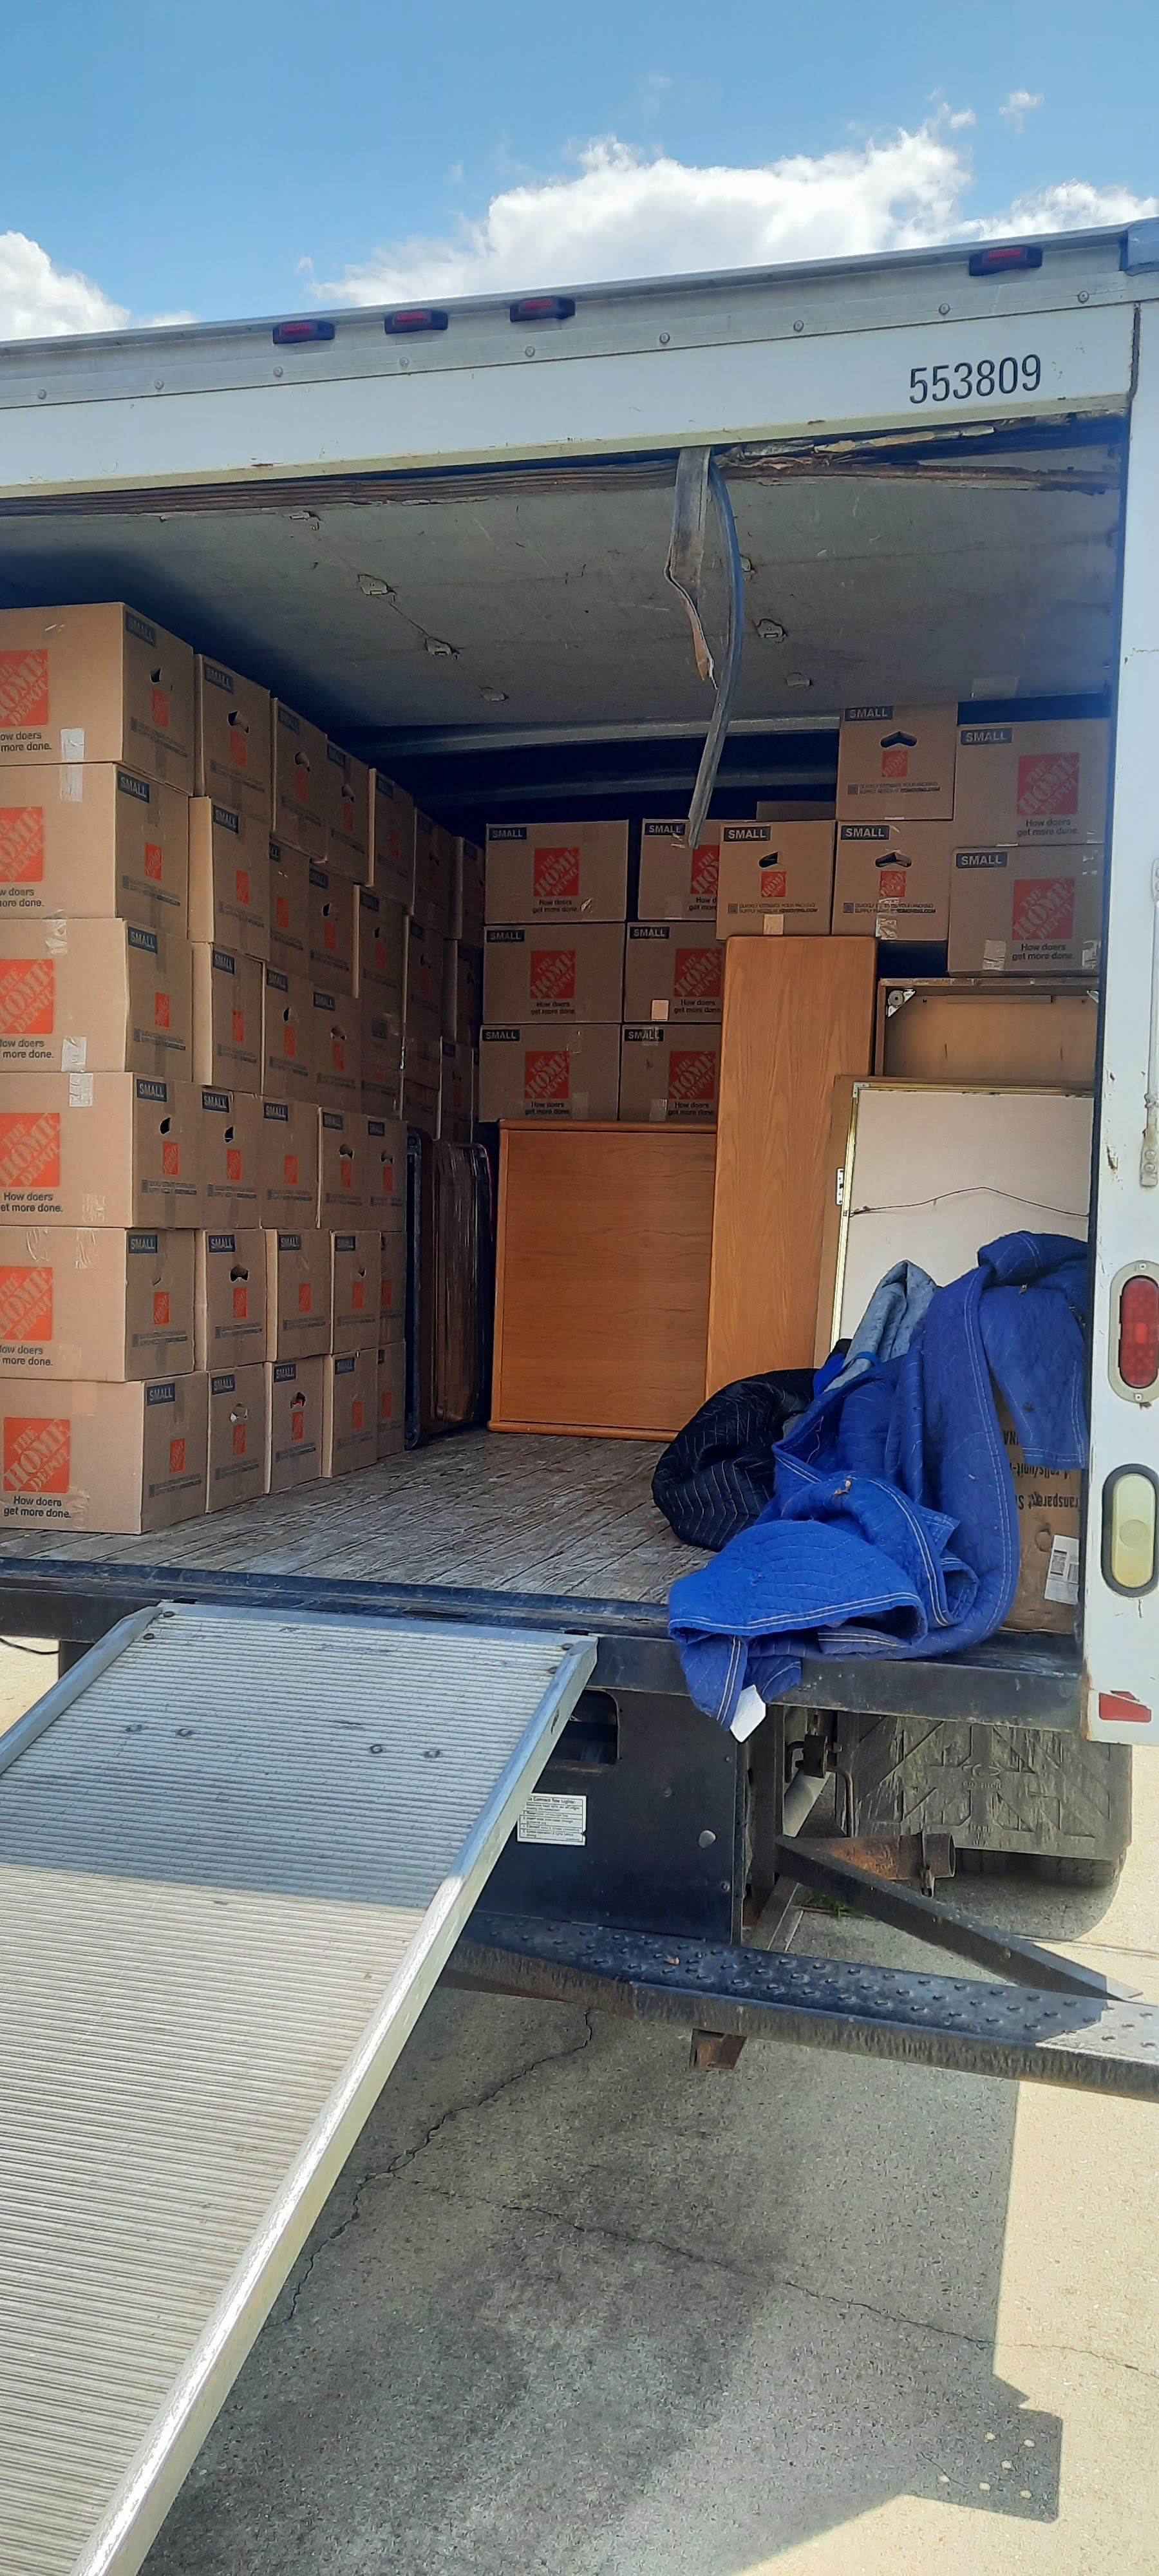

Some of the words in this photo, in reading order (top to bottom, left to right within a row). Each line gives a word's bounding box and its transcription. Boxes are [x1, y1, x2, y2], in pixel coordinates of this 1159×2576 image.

[909, 354, 1041, 404] 553809
[128, 617, 154, 643] SMALL
[849, 707, 887, 718] SMALL
[15, 732, 42, 741] doers
[966, 731, 1007, 742] SMALL
[120, 777, 147, 798] SMALL
[1018, 752, 1079, 815] HOME
[493, 829, 523, 838] SMALL
[649, 825, 681, 833] SMALL
[728, 829, 766, 839] SMALL
[846, 828, 885, 837] SMALL
[1017, 828, 1030, 837] get
[961, 855, 1002, 866] SMALL
[534, 848, 579, 896] HOME
[692, 862, 719, 894] HO
[8, 888, 34, 896] doers
[19, 898, 44, 907] done.
[1013, 880, 1075, 940] HOME
[490, 932, 521, 940] SMALL
[634, 929, 665, 937] SMALL
[131, 931, 155, 949] SMALL
[1021, 943, 1041, 951] How
[1042, 943, 1066, 951] doers
[1012, 953, 1026, 961] get
[531, 951, 576, 998] HOME
[674, 949, 721, 997] HOME
[628, 1030, 660, 1039] SMALL
[18, 1039, 44, 1047] doers
[28, 1050, 54, 1058] done.
[525, 1052, 570, 1099] HOME
[669, 1052, 715, 1099] HOME
[139, 1083, 164, 1098] SMALL
[203, 1096, 227, 1109] SMALL
[265, 1104, 287, 1118] SMALL
[4, 1192, 24, 1201] How
[26, 1192, 53, 1201] doers
[12, 1204, 35, 1212] more
[37, 1204, 62, 1212] done.
[131, 1238, 155, 1250] SMALL
[211, 1237, 233, 1249] SMALL
[17, 1346, 43, 1354] doers
[28, 1357, 53, 1366] done.
[214, 1378, 234, 1391] SMALL
[149, 1388, 173, 1401] SMALL
[4, 1419, 71, 1492] HOME
[14, 1496, 34, 1505] How
[36, 1497, 62, 1506] doers
[1027, 1492, 1079, 1510] ransparent
[4, 1507, 18, 1517] get
[21, 1509, 43, 1517] more
[46, 1509, 71, 1519] done.
